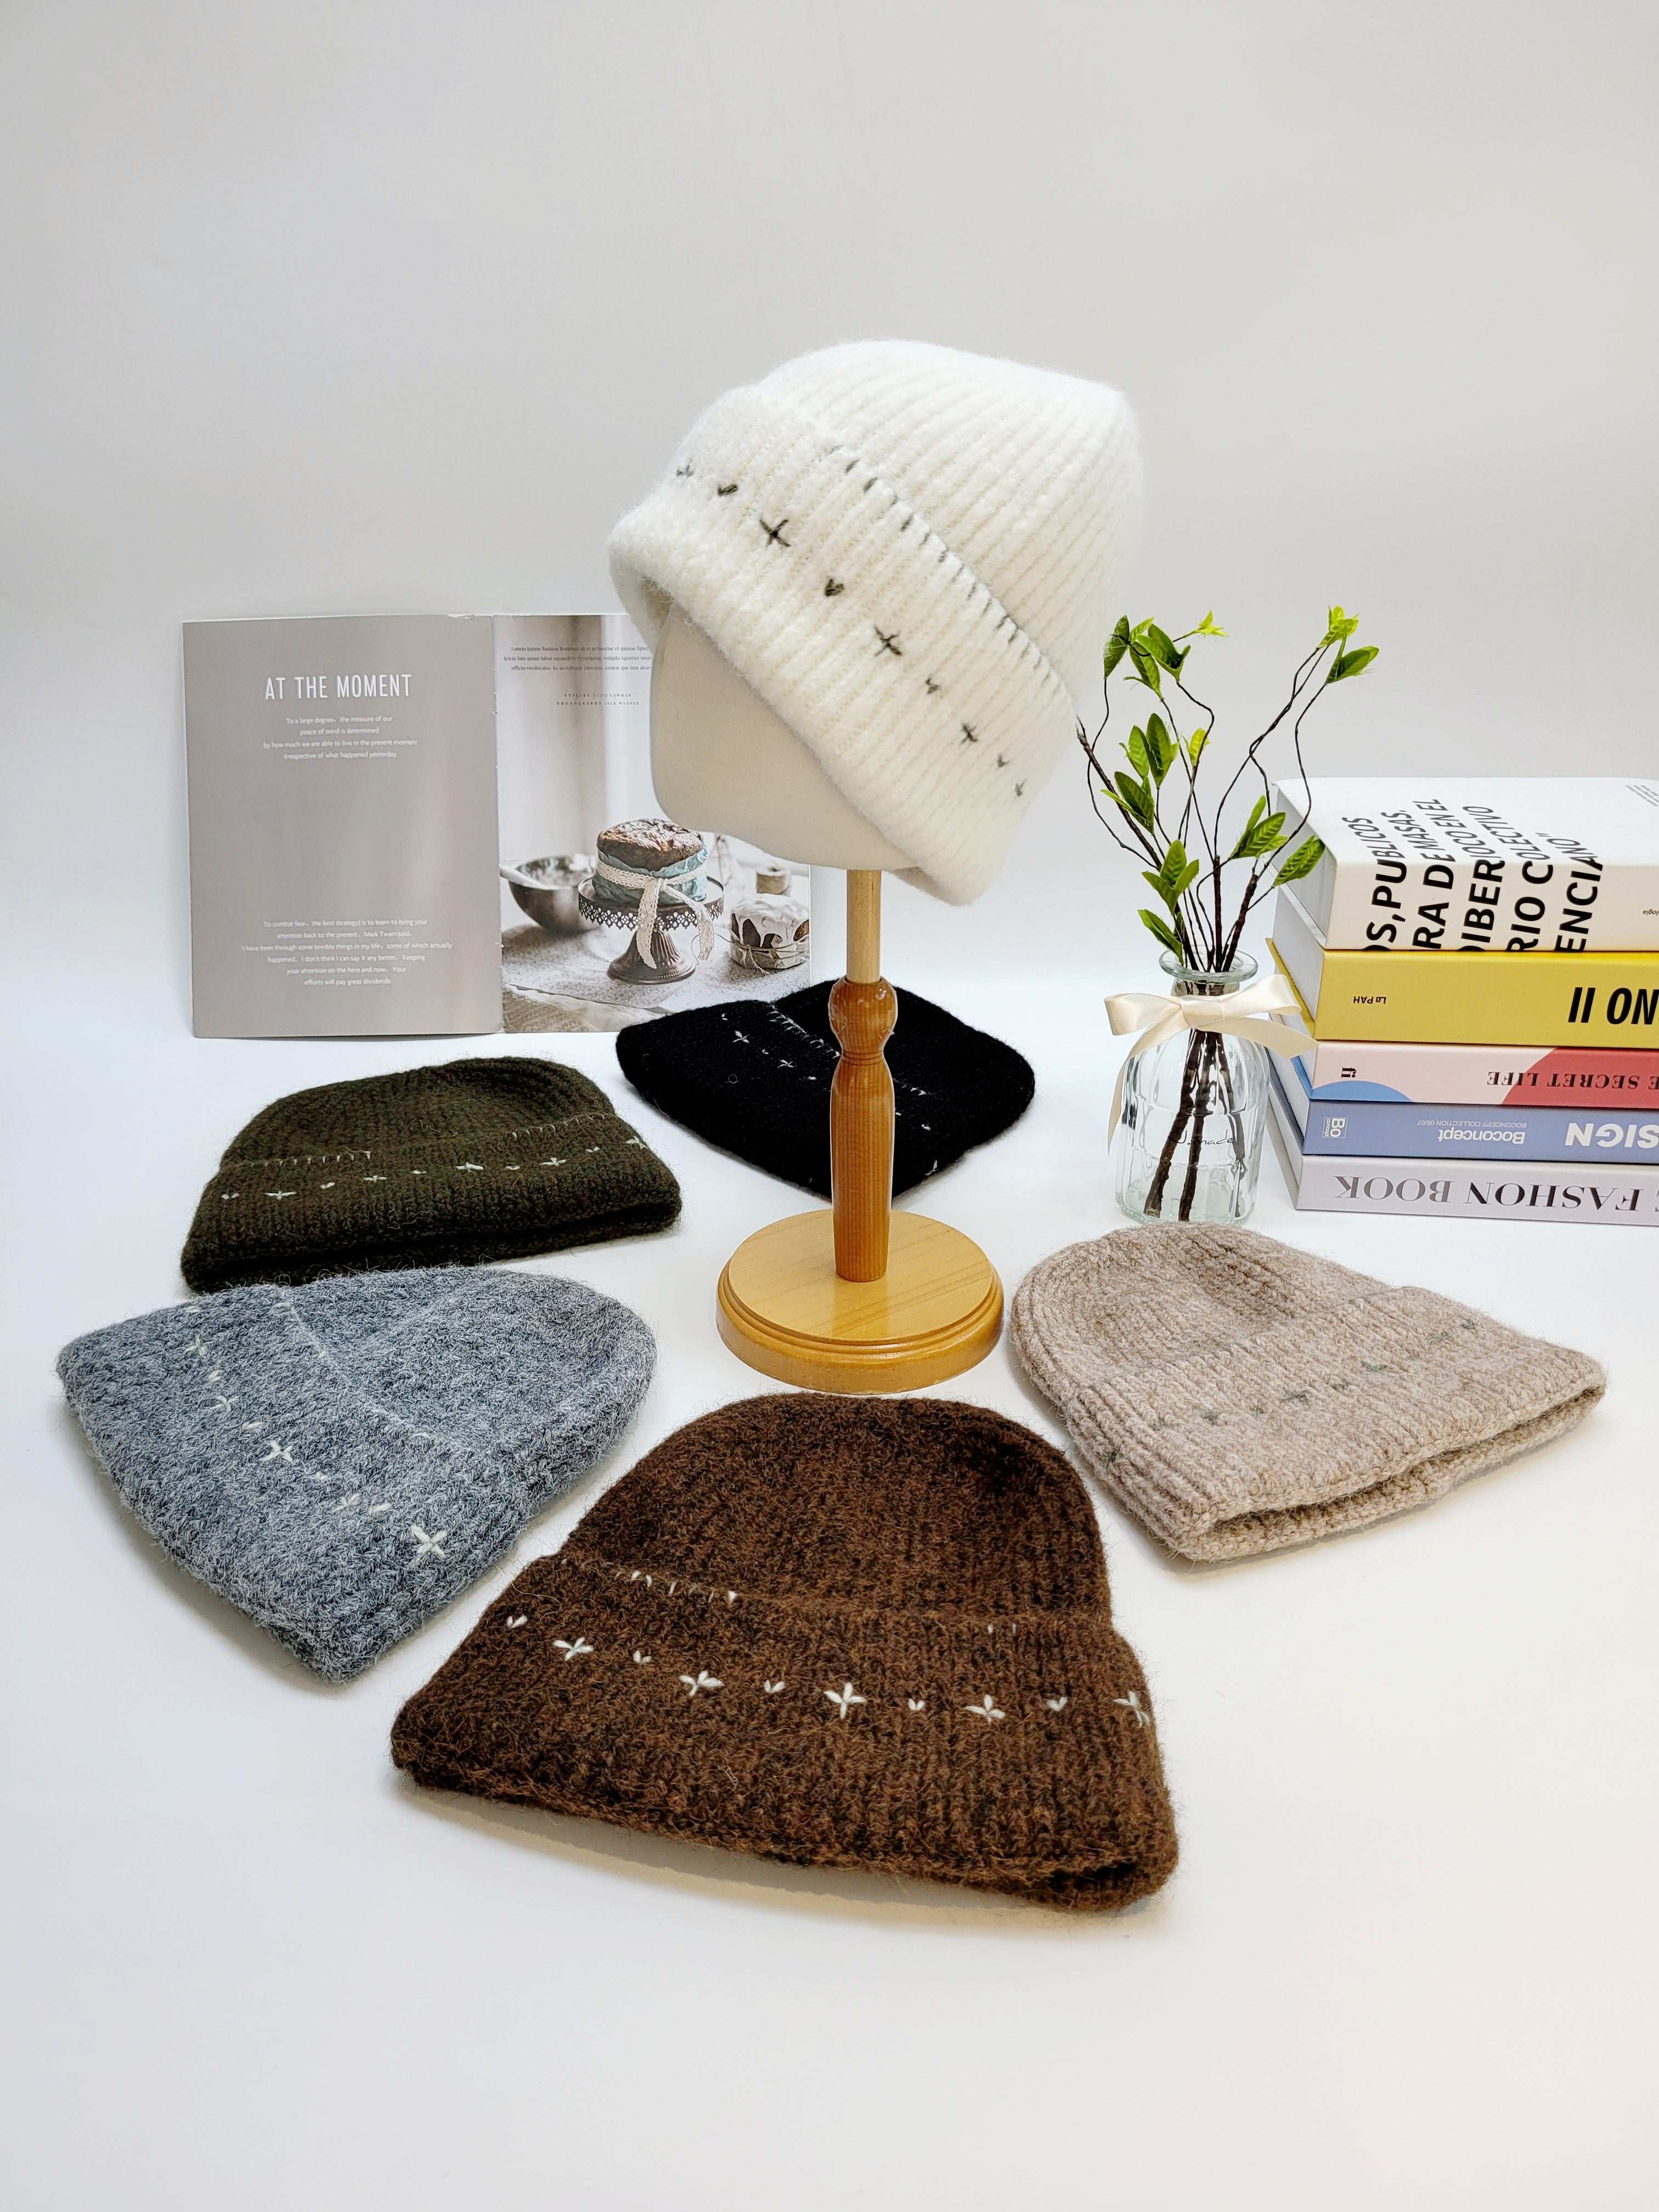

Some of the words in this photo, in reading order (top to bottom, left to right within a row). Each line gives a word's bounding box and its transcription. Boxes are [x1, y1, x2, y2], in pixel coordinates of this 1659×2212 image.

[266, 677, 286, 700] AT
[294, 676, 328, 699] THE
[337, 674, 411, 698] MOMENT
[369, 751, 397, 759] yesterday
[1412, 799, 1448, 811] EL
[1424, 812, 1467, 829] EN
[1462, 806, 1554, 884] COLECTIVO
[1420, 851, 1456, 890] DE
[399, 918, 413, 927] bring
[1412, 902, 1450, 949] RA
[1506, 896, 1546, 951] RIO
[275, 944, 297, 952] through
[1353, 996, 1373, 1004] PAH
[1567, 987, 1596, 1024] II
[1606, 988, 1659, 1025] NO
[1487, 1071, 1539, 1087] LIFE
[1547, 1073, 1640, 1090] SECRET
[1330, 1118, 1346, 1137] Bo
[1437, 1127, 1526, 1144] Boconcept
[1332, 1175, 1455, 1203] BOOK
[1463, 1181, 1644, 1212] FASHON
